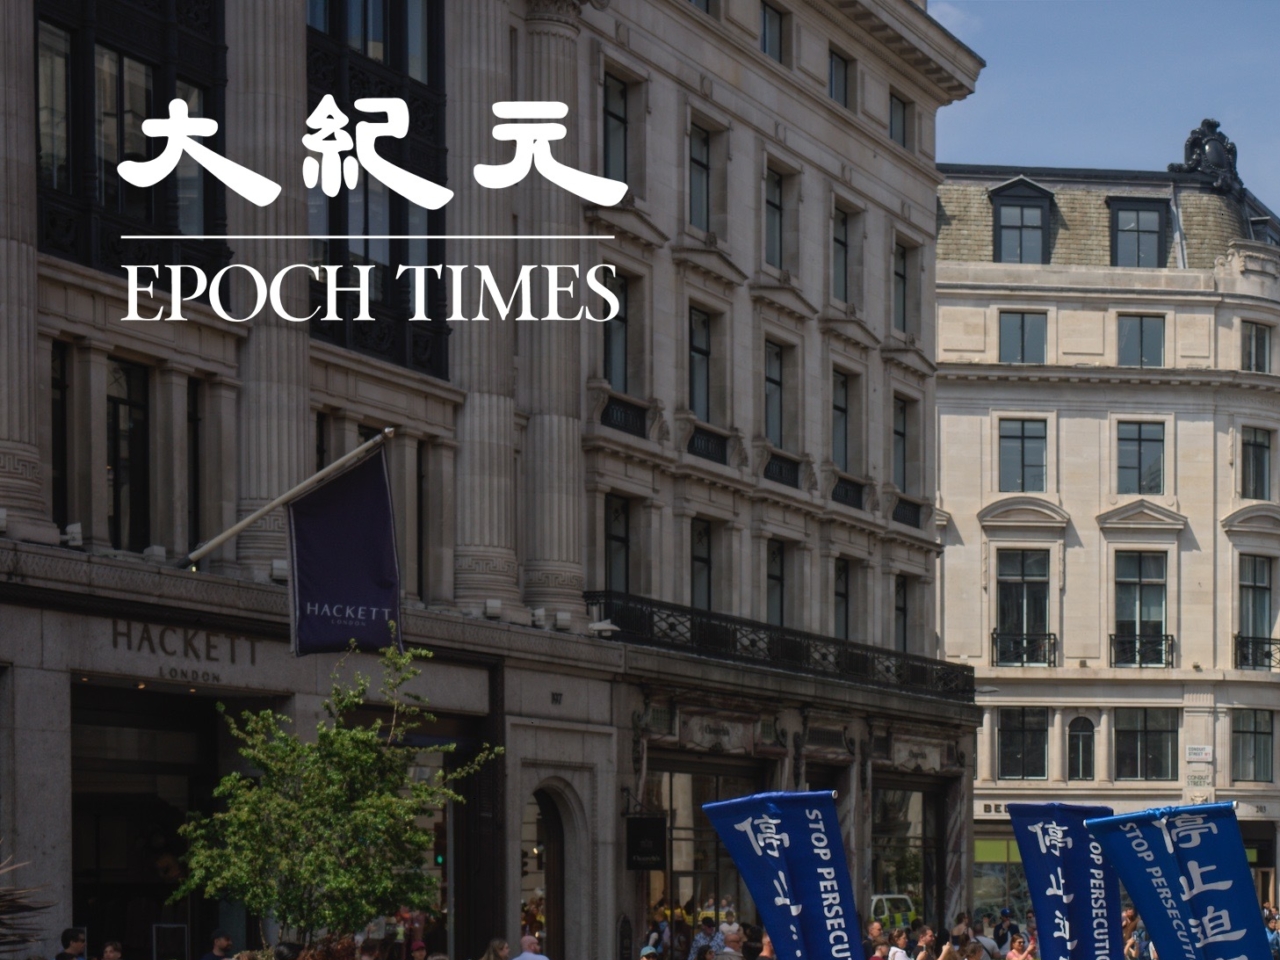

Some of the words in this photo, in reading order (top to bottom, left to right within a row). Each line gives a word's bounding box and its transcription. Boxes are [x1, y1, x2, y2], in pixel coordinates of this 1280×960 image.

[306, 602, 392, 621] HACKETT
[112, 619, 264, 666] HACKETT
[159, 666, 222, 684] LONDON
[805, 808, 831, 861] STOP
[1119, 822, 1154, 866] STOP
